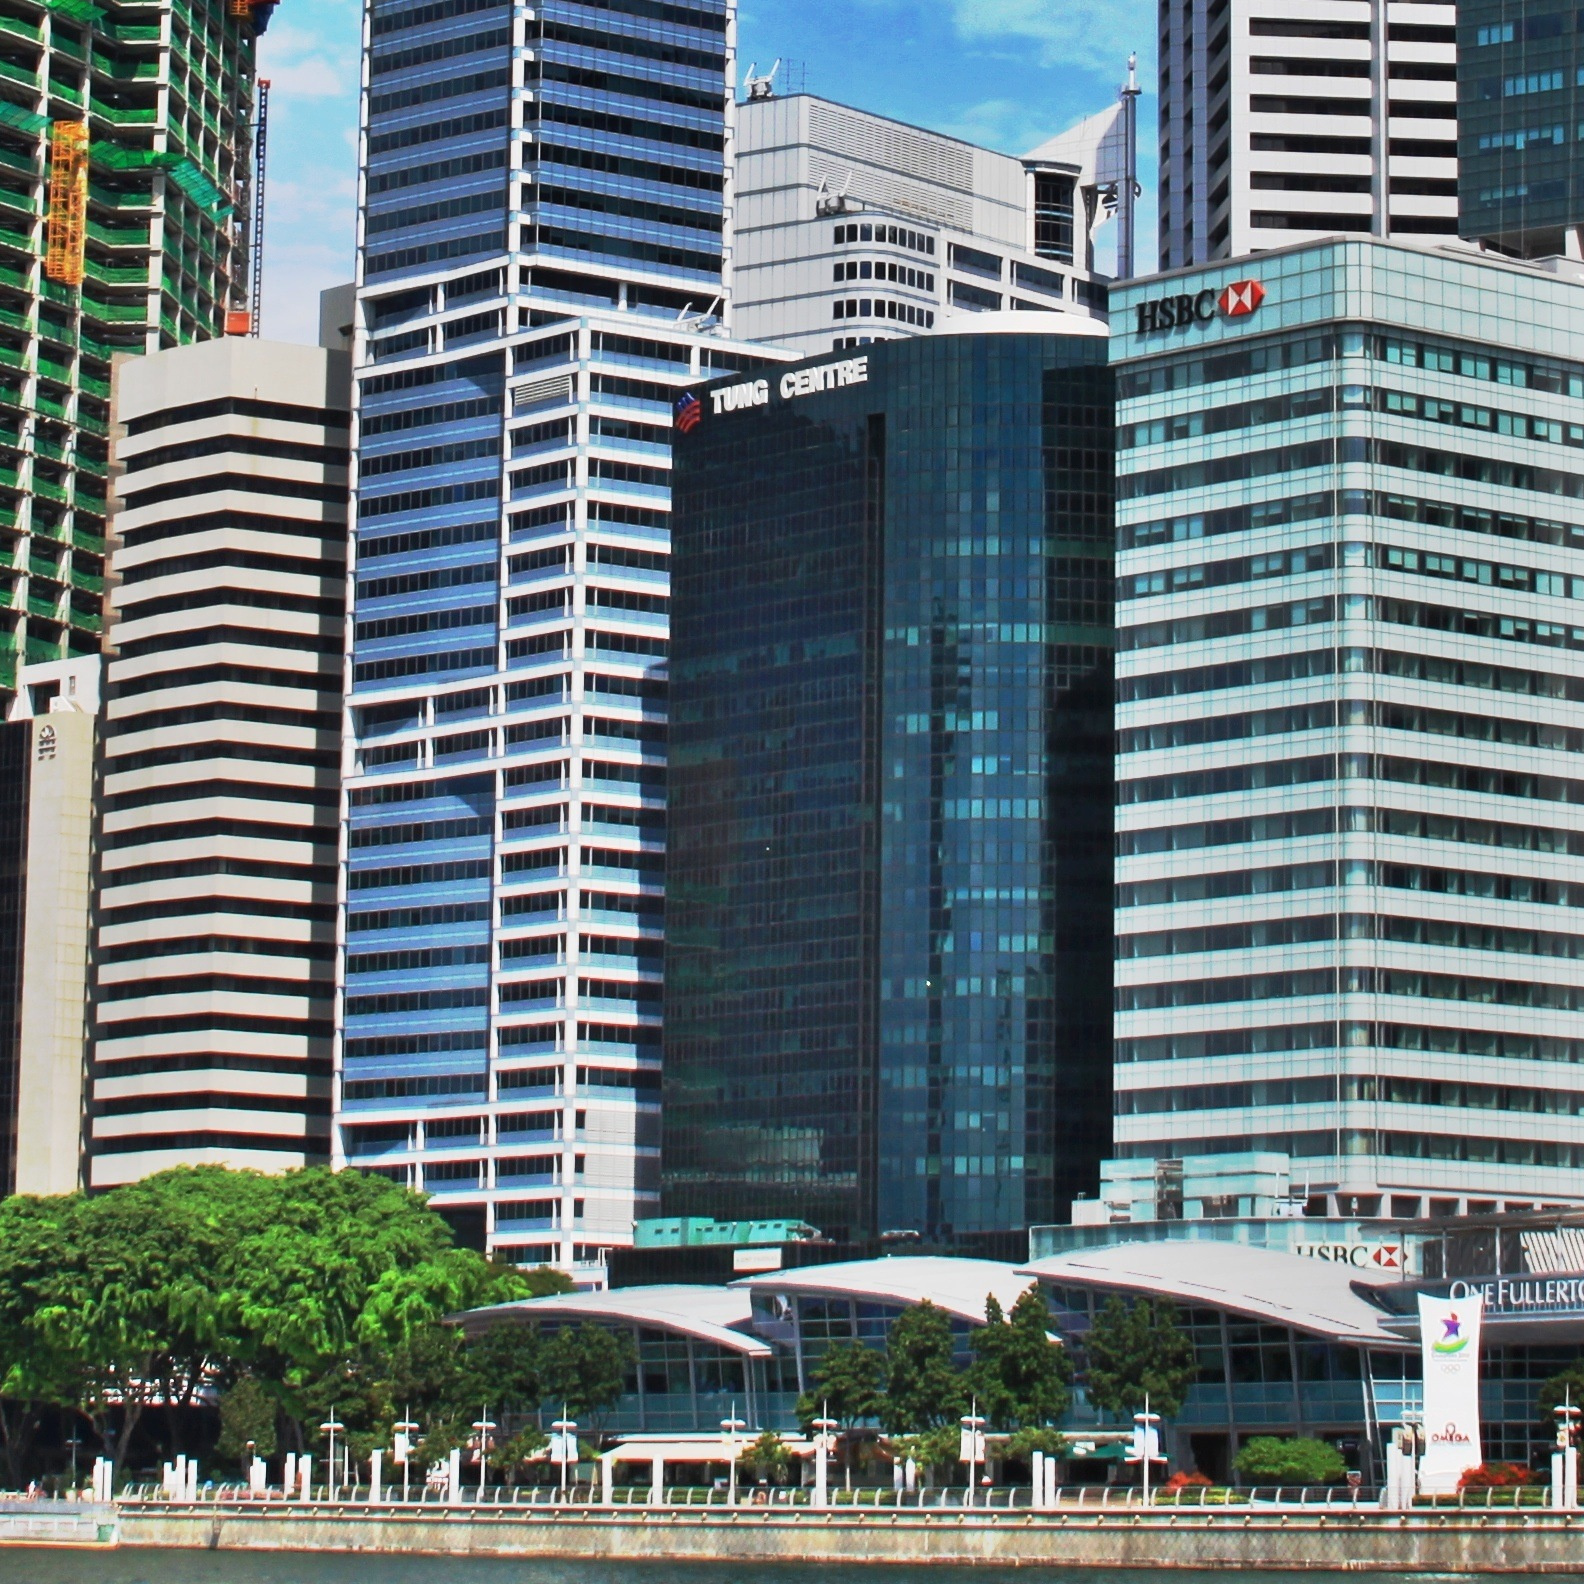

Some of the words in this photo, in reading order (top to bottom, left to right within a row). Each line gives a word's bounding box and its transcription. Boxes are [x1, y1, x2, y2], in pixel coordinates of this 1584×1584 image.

[1136, 287, 1216, 334] HSBC
[709, 378, 769, 415] TUNG
[779, 355, 868, 399] CENTRE
[1297, 1245, 1368, 1268] HSBC
[1450, 1280, 1495, 1306] ONE
